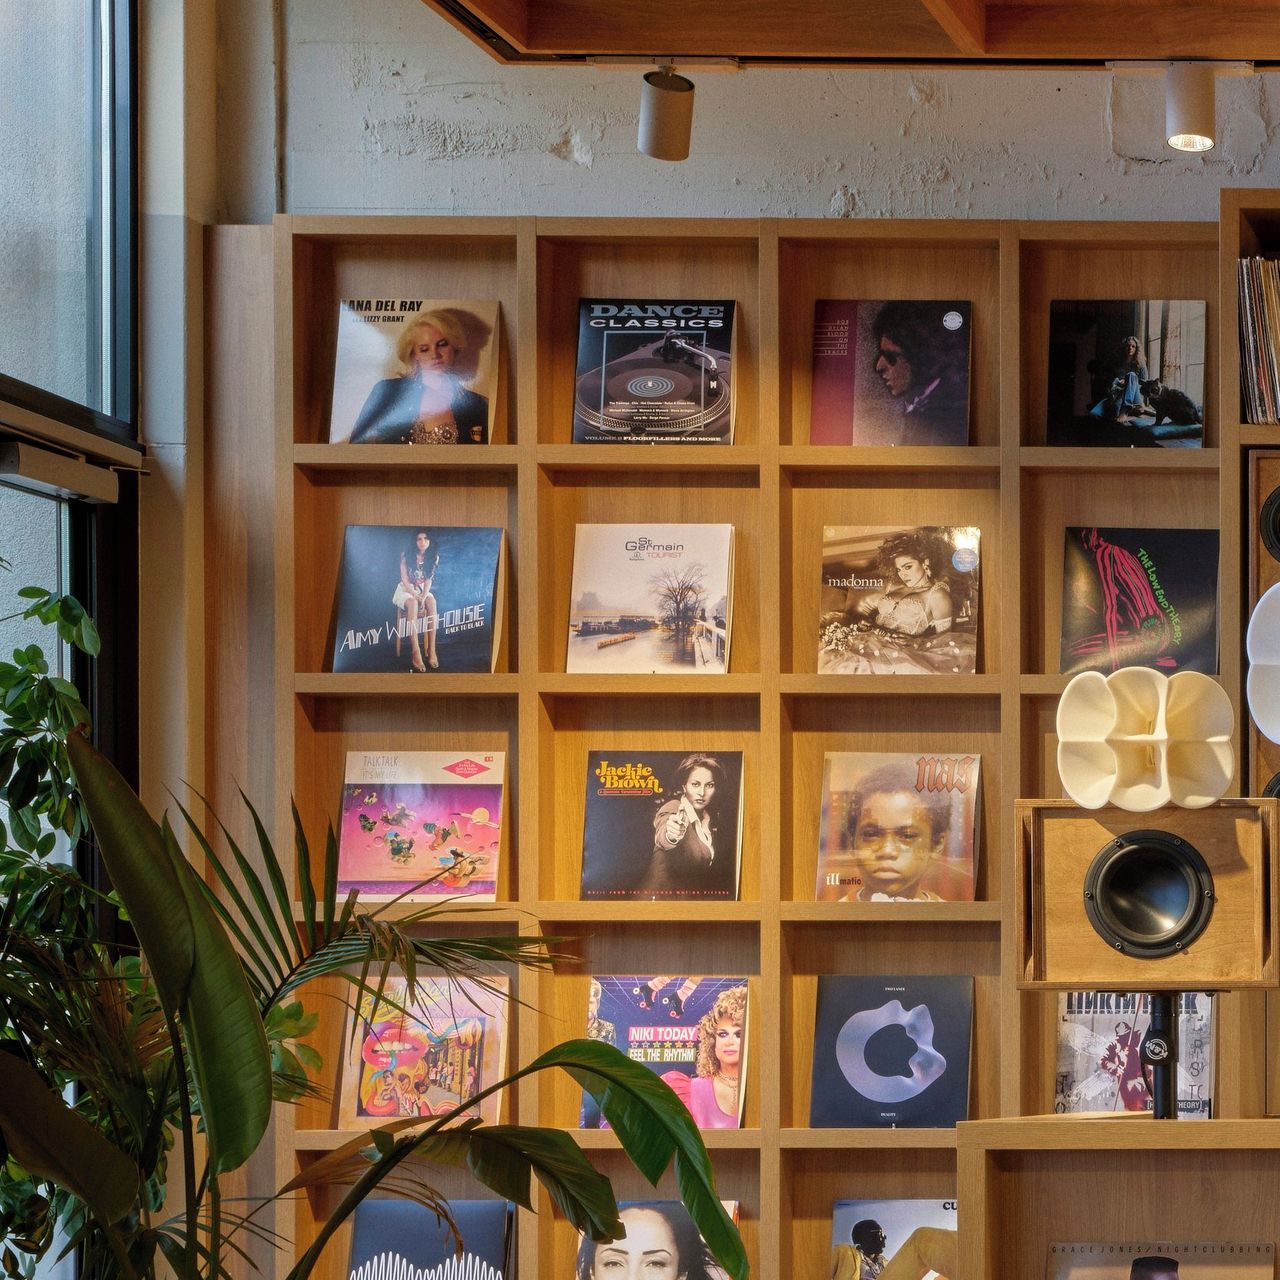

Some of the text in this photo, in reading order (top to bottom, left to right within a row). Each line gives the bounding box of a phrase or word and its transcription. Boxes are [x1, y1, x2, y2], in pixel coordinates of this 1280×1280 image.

[375, 300, 396, 312] DEL
[399, 300, 423, 312] RAY
[590, 304, 725, 318] DANCE
[382, 315, 405, 323] GRANT
[589, 319, 724, 328] CLASSICS
[829, 573, 884, 587] madonna
[1137, 548, 1154, 569] THE
[1147, 567, 1162, 590] LOW
[1155, 589, 1170, 609] END
[340, 626, 383, 653] AMY
[596, 760, 653, 779] Jackie
[915, 756, 976, 793] nas
[600, 776, 664, 794] Brown
[826, 872, 862, 886] illmatic
[630, 1027, 697, 1041] NIKI TODAY
[647, 1048, 661, 1061] THE
[663, 1048, 695, 1062] RHYTHM
